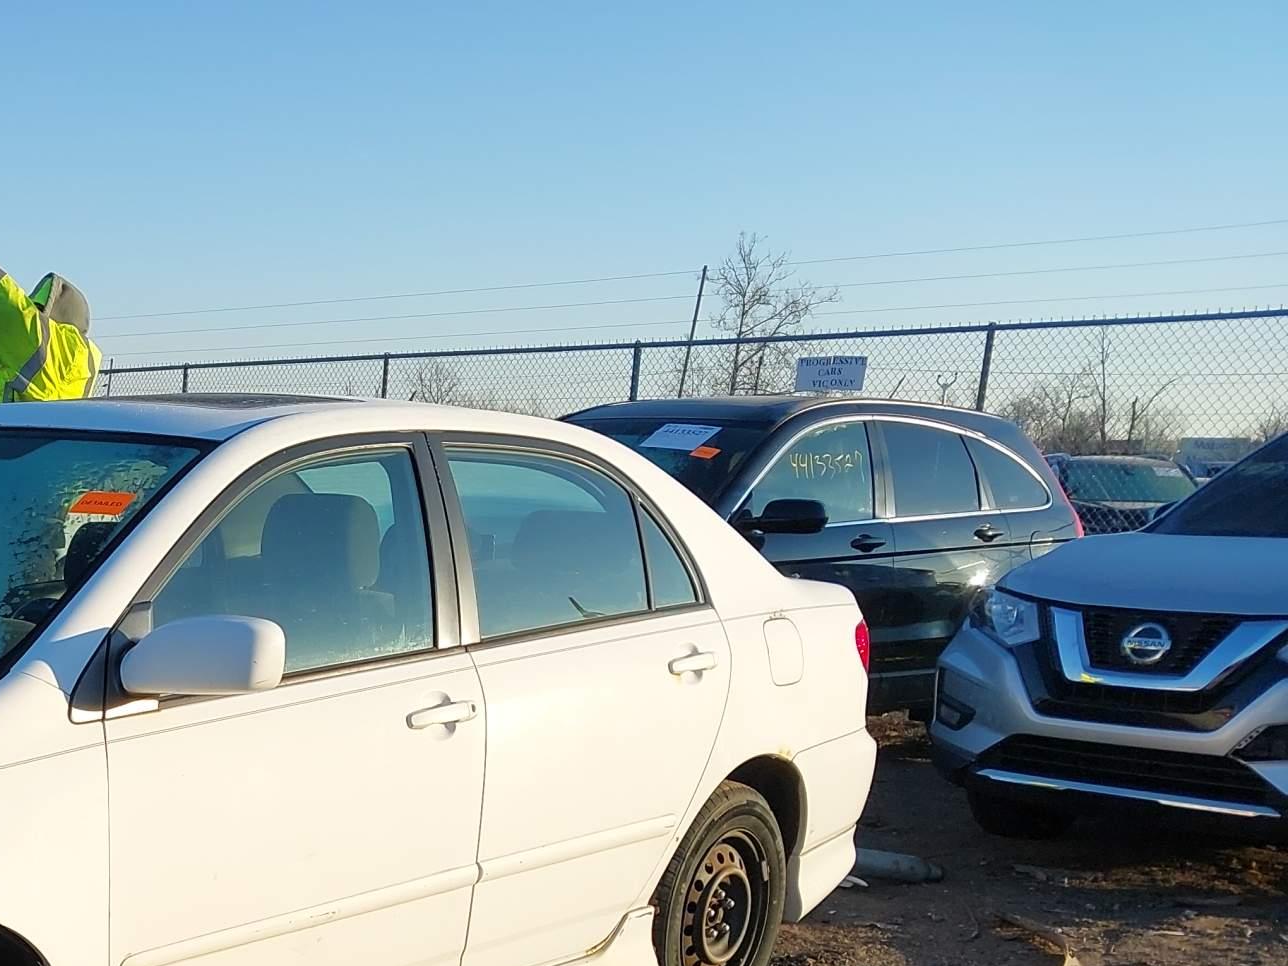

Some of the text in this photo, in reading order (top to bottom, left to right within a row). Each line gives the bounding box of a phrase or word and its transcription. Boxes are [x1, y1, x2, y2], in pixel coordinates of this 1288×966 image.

[799, 356, 867, 367] PROGRESSIVE
[817, 367, 844, 377] CARS
[811, 378, 856, 388] VIC ONLY
[1126, 639, 1166, 648] NISSAN
